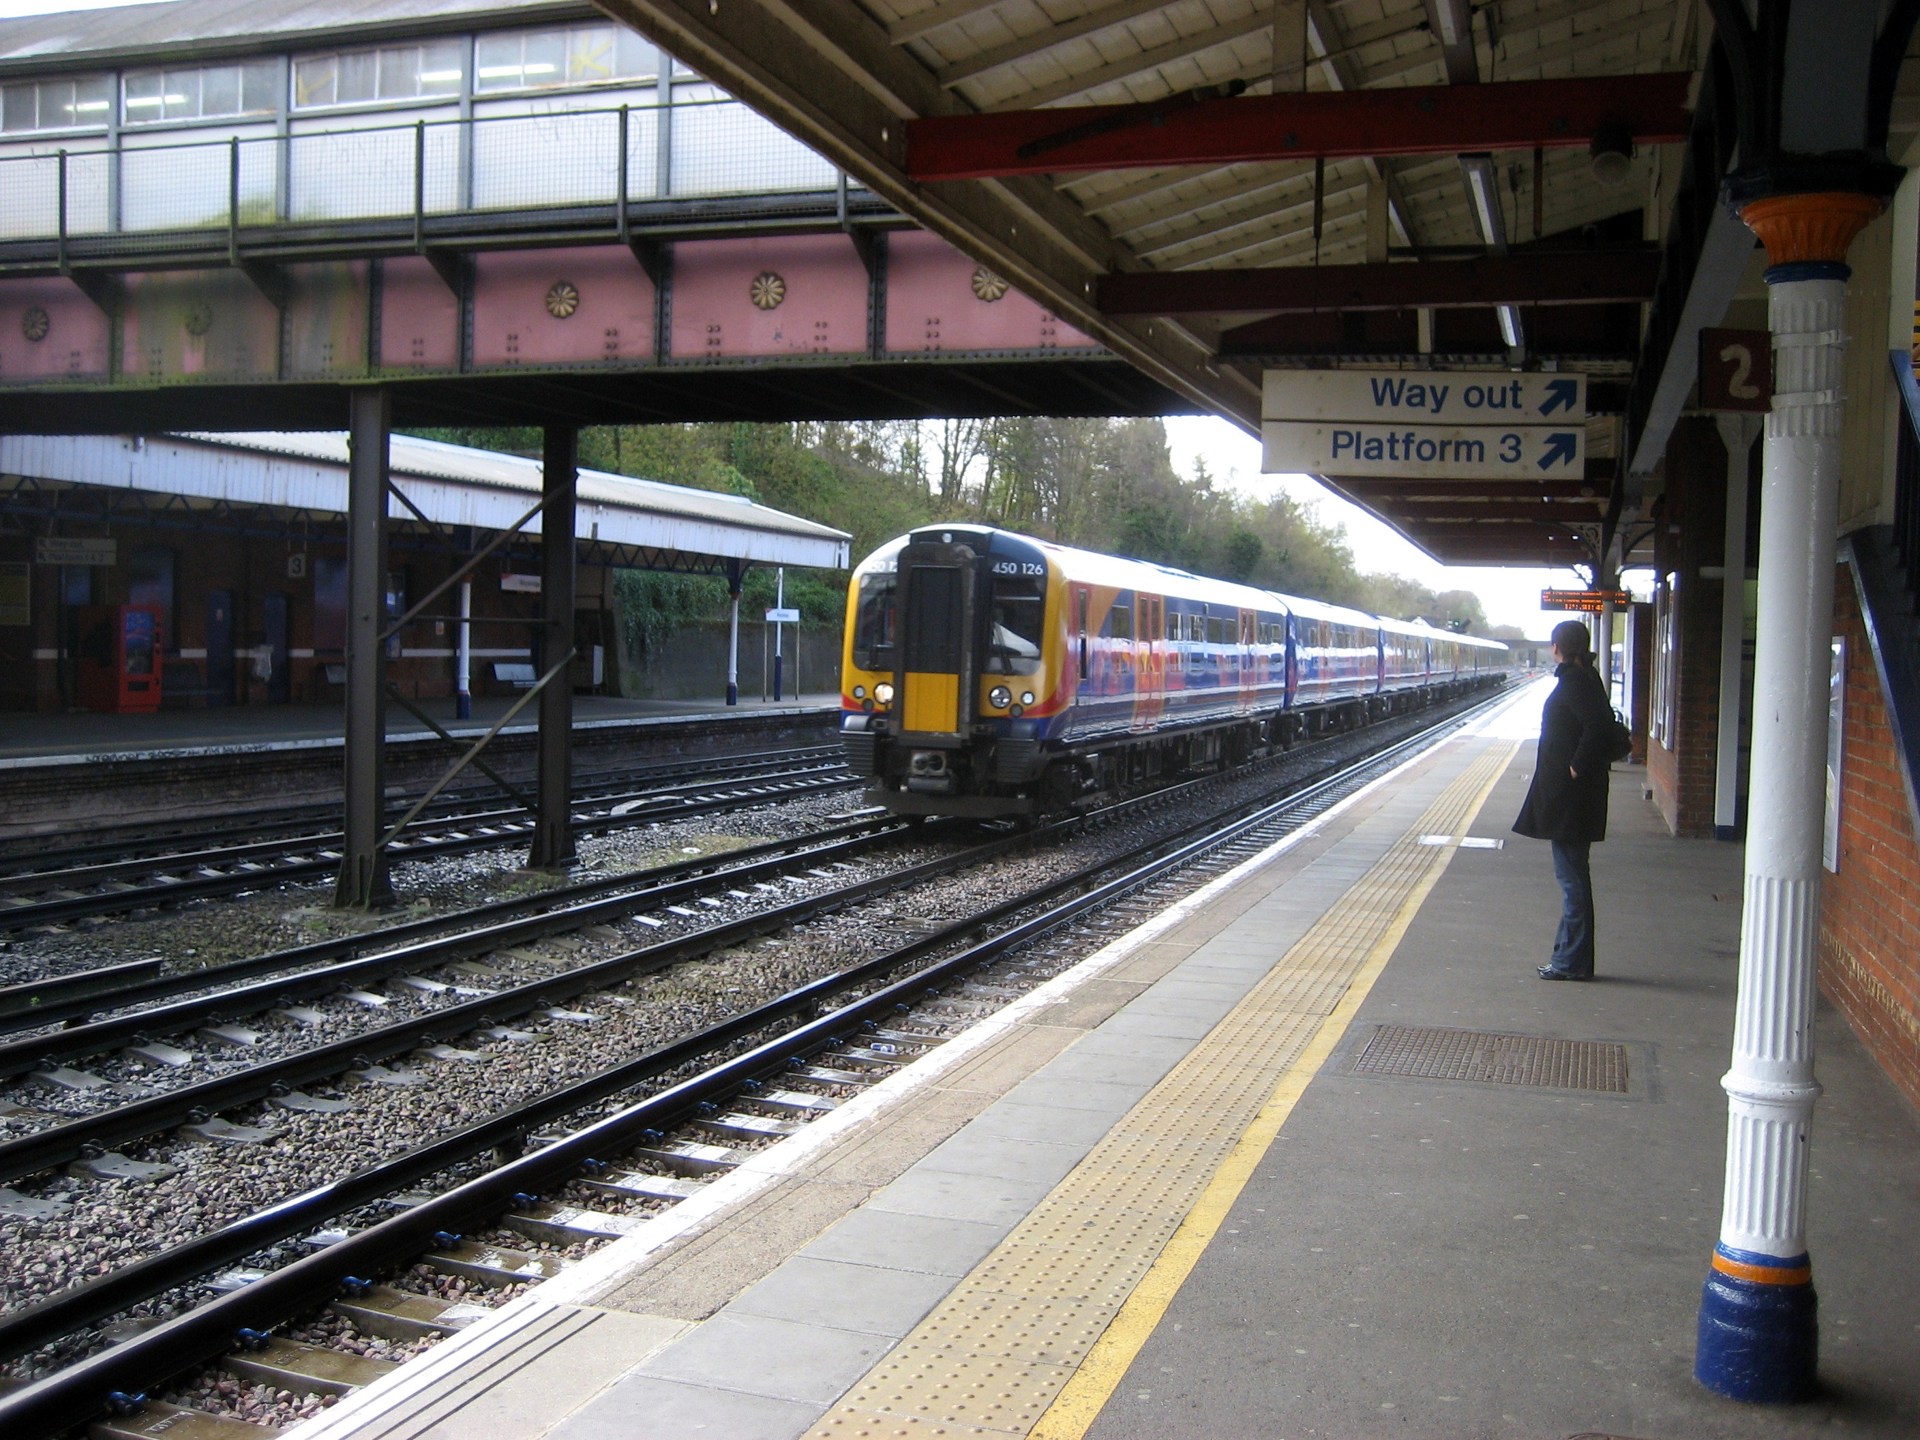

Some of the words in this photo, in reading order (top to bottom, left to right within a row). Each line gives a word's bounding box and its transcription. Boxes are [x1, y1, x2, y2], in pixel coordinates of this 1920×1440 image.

[1720, 344, 1760, 400] 2
[1370, 377, 1450, 414] Way
[1463, 379, 1523, 409] out
[1331, 430, 1485, 463] Platform
[1499, 433, 1523, 463] 3
[292, 557, 302, 574] 3
[992, 562, 1017, 574] 450
[1022, 563, 1044, 575] 126
